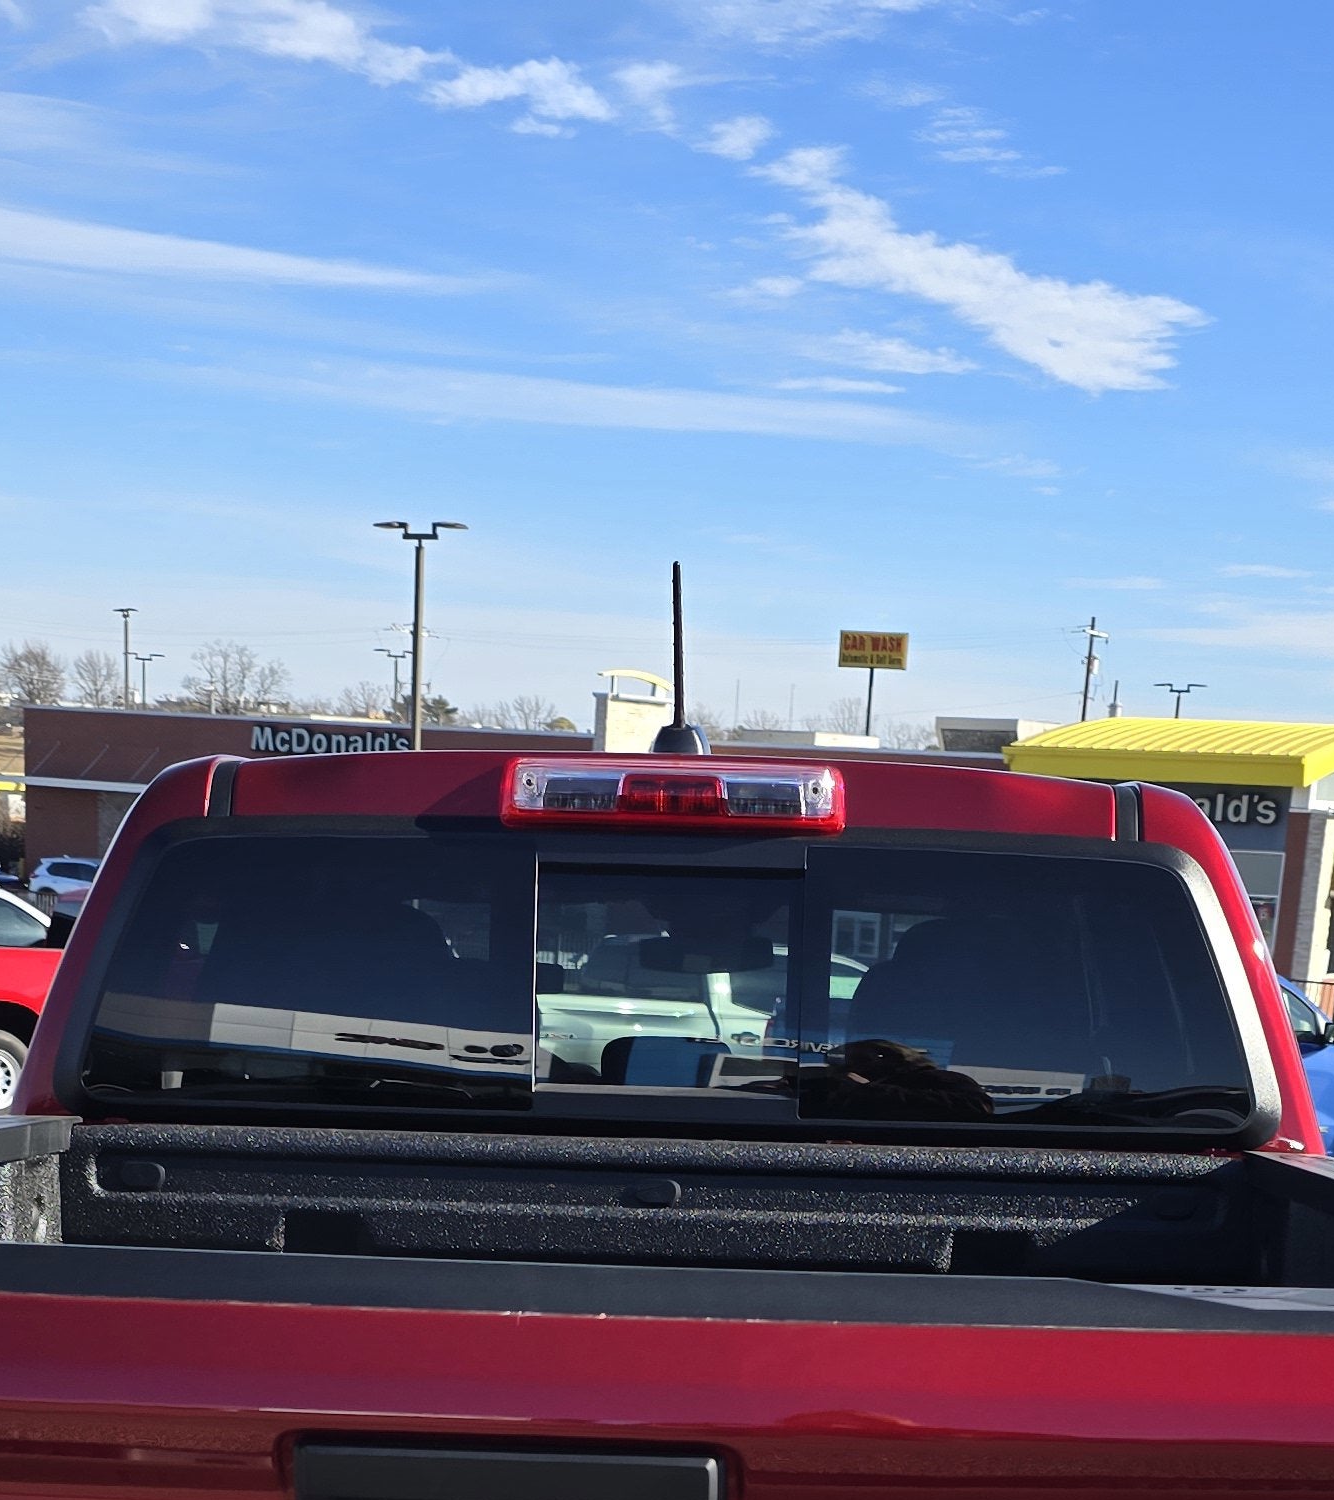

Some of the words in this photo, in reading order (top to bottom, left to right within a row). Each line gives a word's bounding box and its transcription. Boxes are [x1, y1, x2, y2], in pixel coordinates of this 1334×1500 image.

[844, 633, 865, 651] CAR
[872, 636, 901, 653] WASH
[250, 725, 410, 753] McDonald's
